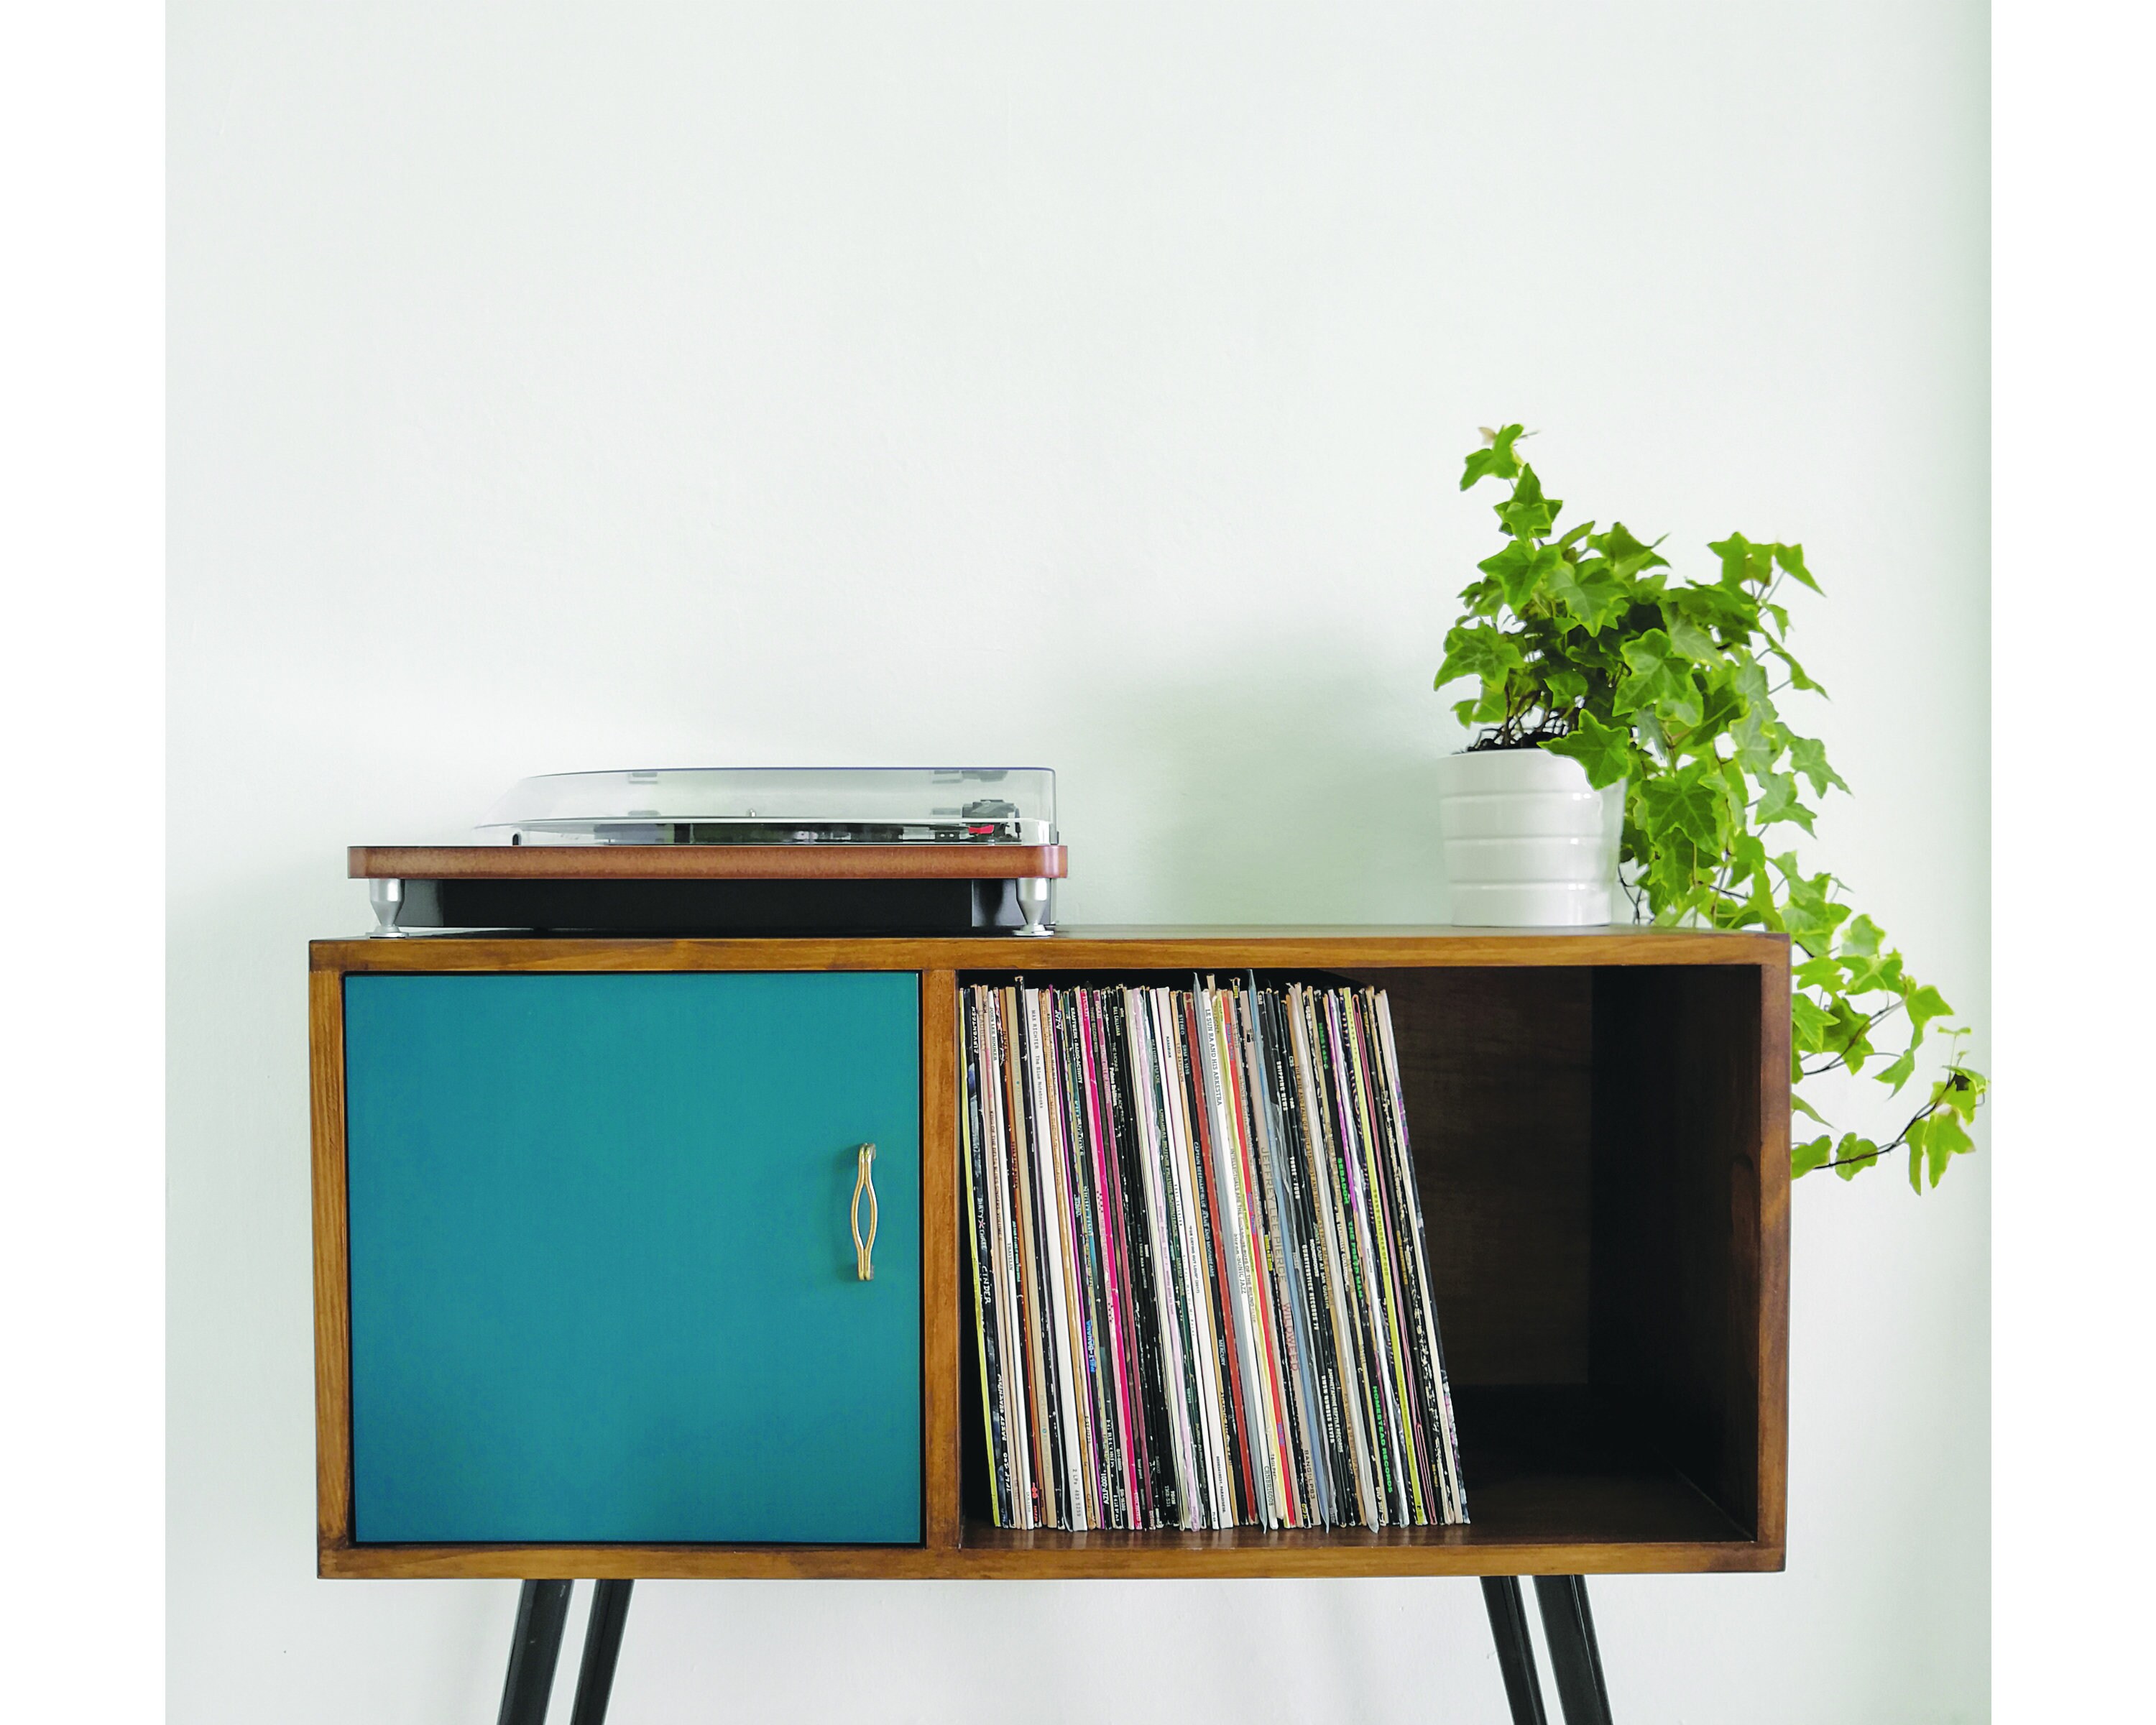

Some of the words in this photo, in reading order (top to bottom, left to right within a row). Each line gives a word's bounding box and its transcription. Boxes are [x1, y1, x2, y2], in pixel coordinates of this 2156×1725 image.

[1074, 1042, 1082, 1083] RADIO-ACTIVITY
[1208, 1033, 1214, 1042] RA
[1212, 1071, 1222, 1105] ARKESTRA
[1276, 1061, 1285, 1090] SHIPPING
[1261, 1147, 1275, 1201] JEFFREY
[1337, 1158, 1349, 1204] SEBADOH
[1169, 1195, 1178, 1236] SOUNDTRACK
[1268, 1208, 1279, 1230] LEE
[1376, 1215, 1385, 1250] CHILDREN
[1205, 1241, 1215, 1276] MOONBEAMS
[1272, 1236, 1286, 1282] PIERCE
[981, 1265, 991, 1304] CINDER
[1302, 1244, 1313, 1290] QUARTERSTICK
[1308, 1292, 1317, 1320] RECORDS
[1084, 1320, 1096, 1372] MELT-BANANA
[1282, 1302, 1299, 1371] WILDWEED
[1327, 1368, 1337, 1406] AMPHETAMINE
[1373, 1386, 1386, 1445] HOMESTEAD
[1381, 1448, 1393, 1493] RECORDS
